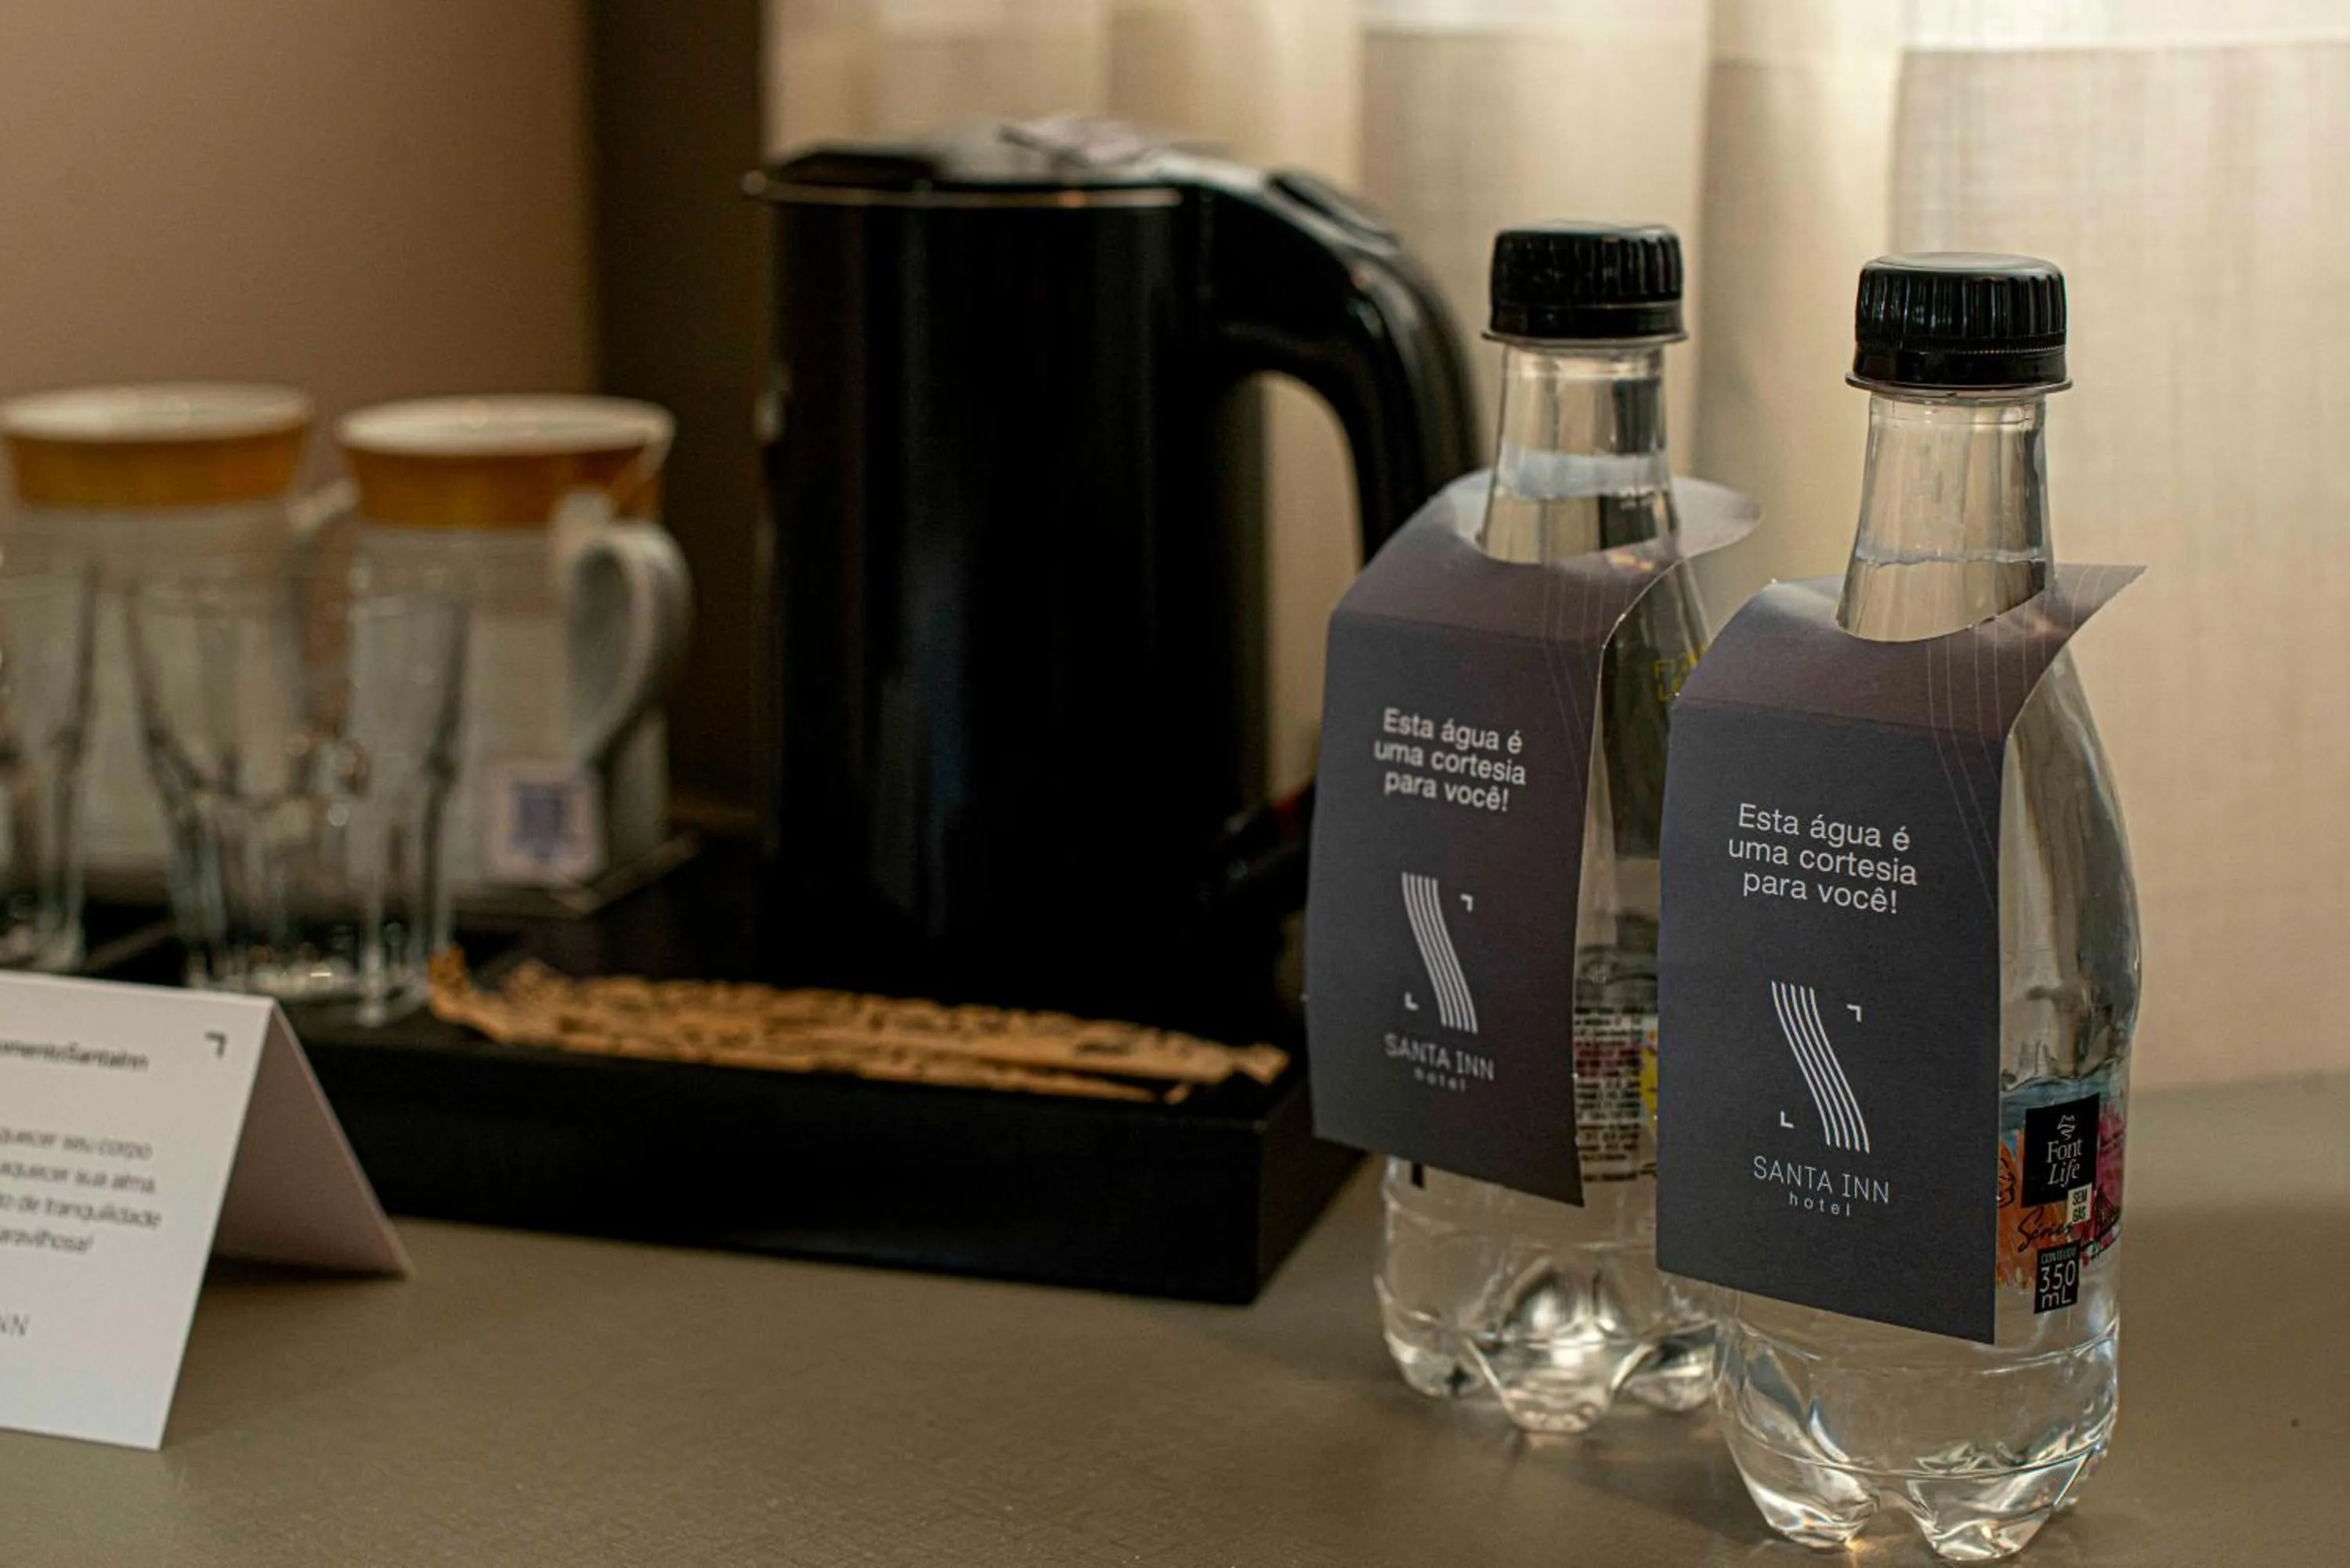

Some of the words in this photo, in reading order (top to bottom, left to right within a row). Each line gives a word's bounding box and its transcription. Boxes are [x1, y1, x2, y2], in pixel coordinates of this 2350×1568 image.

[1383, 707, 1434, 740] Esta
[1441, 717, 1499, 752] água
[1506, 729, 1523, 754] é
[1373, 740, 1424, 767] uma
[1430, 750, 1527, 786] cortesia
[1383, 771, 1437, 799] para
[1444, 782, 1509, 812] você!
[1738, 803, 1799, 835] Esta
[1810, 814, 1882, 848] água
[1892, 826, 1911, 851] é
[1729, 839, 1789, 865] uma
[1799, 850, 1918, 886] cortesia
[1743, 871, 1808, 901] para
[1817, 884, 1897, 915] você!
[1384, 1031, 1451, 1070] SANTA
[1455, 1050, 1495, 1082] INN
[1413, 1066, 1466, 1093] hotel
[2045, 1136, 2084, 1164] Font
[1753, 1155, 1833, 1194] SANTA
[1842, 1172, 1889, 1205] INN
[2047, 1158, 2081, 1188] Life
[1789, 1191, 1850, 1217] hotel
[2072, 1187, 2088, 1205] SEM
[2039, 1259, 2077, 1293] 350
[2041, 1284, 2072, 1309] mL
